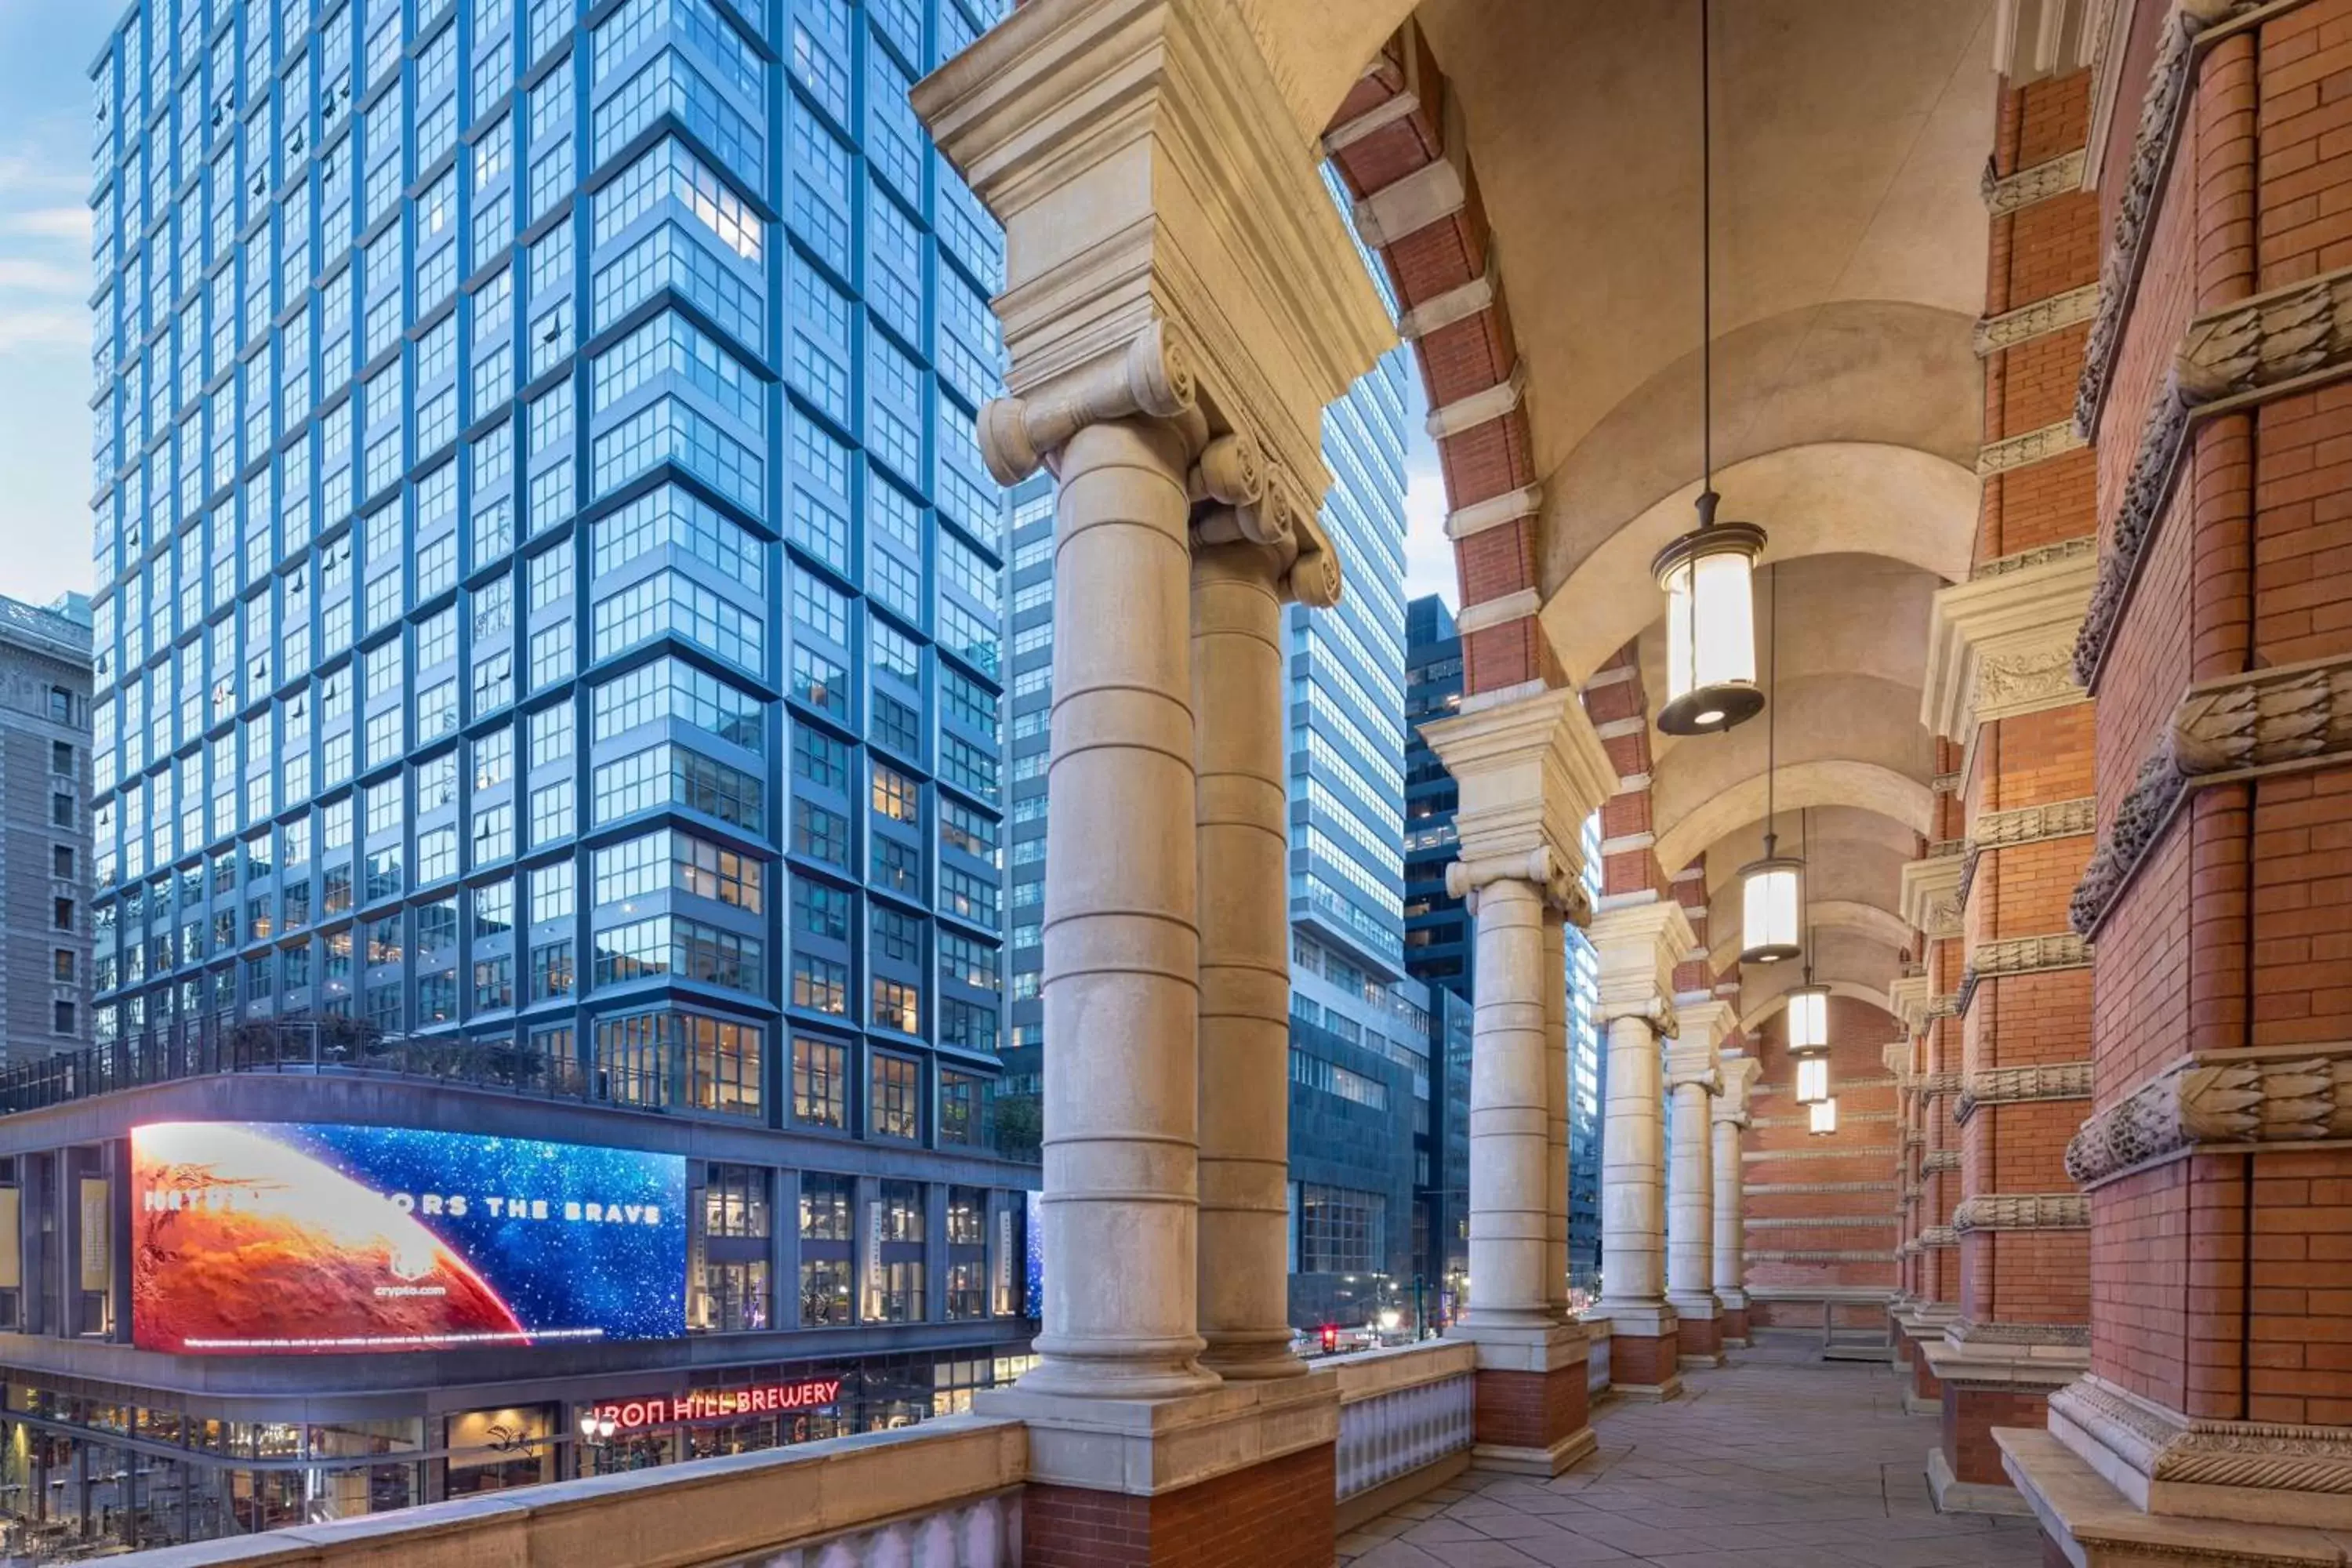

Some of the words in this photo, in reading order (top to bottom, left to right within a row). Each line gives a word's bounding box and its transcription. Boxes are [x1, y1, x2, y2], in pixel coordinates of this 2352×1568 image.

[485, 1196, 548, 1220] THE
[564, 1201, 660, 1225] BRAVE
[374, 1286, 446, 1298] crypto.com
[673, 1392, 731, 1421] HILL
[737, 1381, 840, 1414] BREWERY
